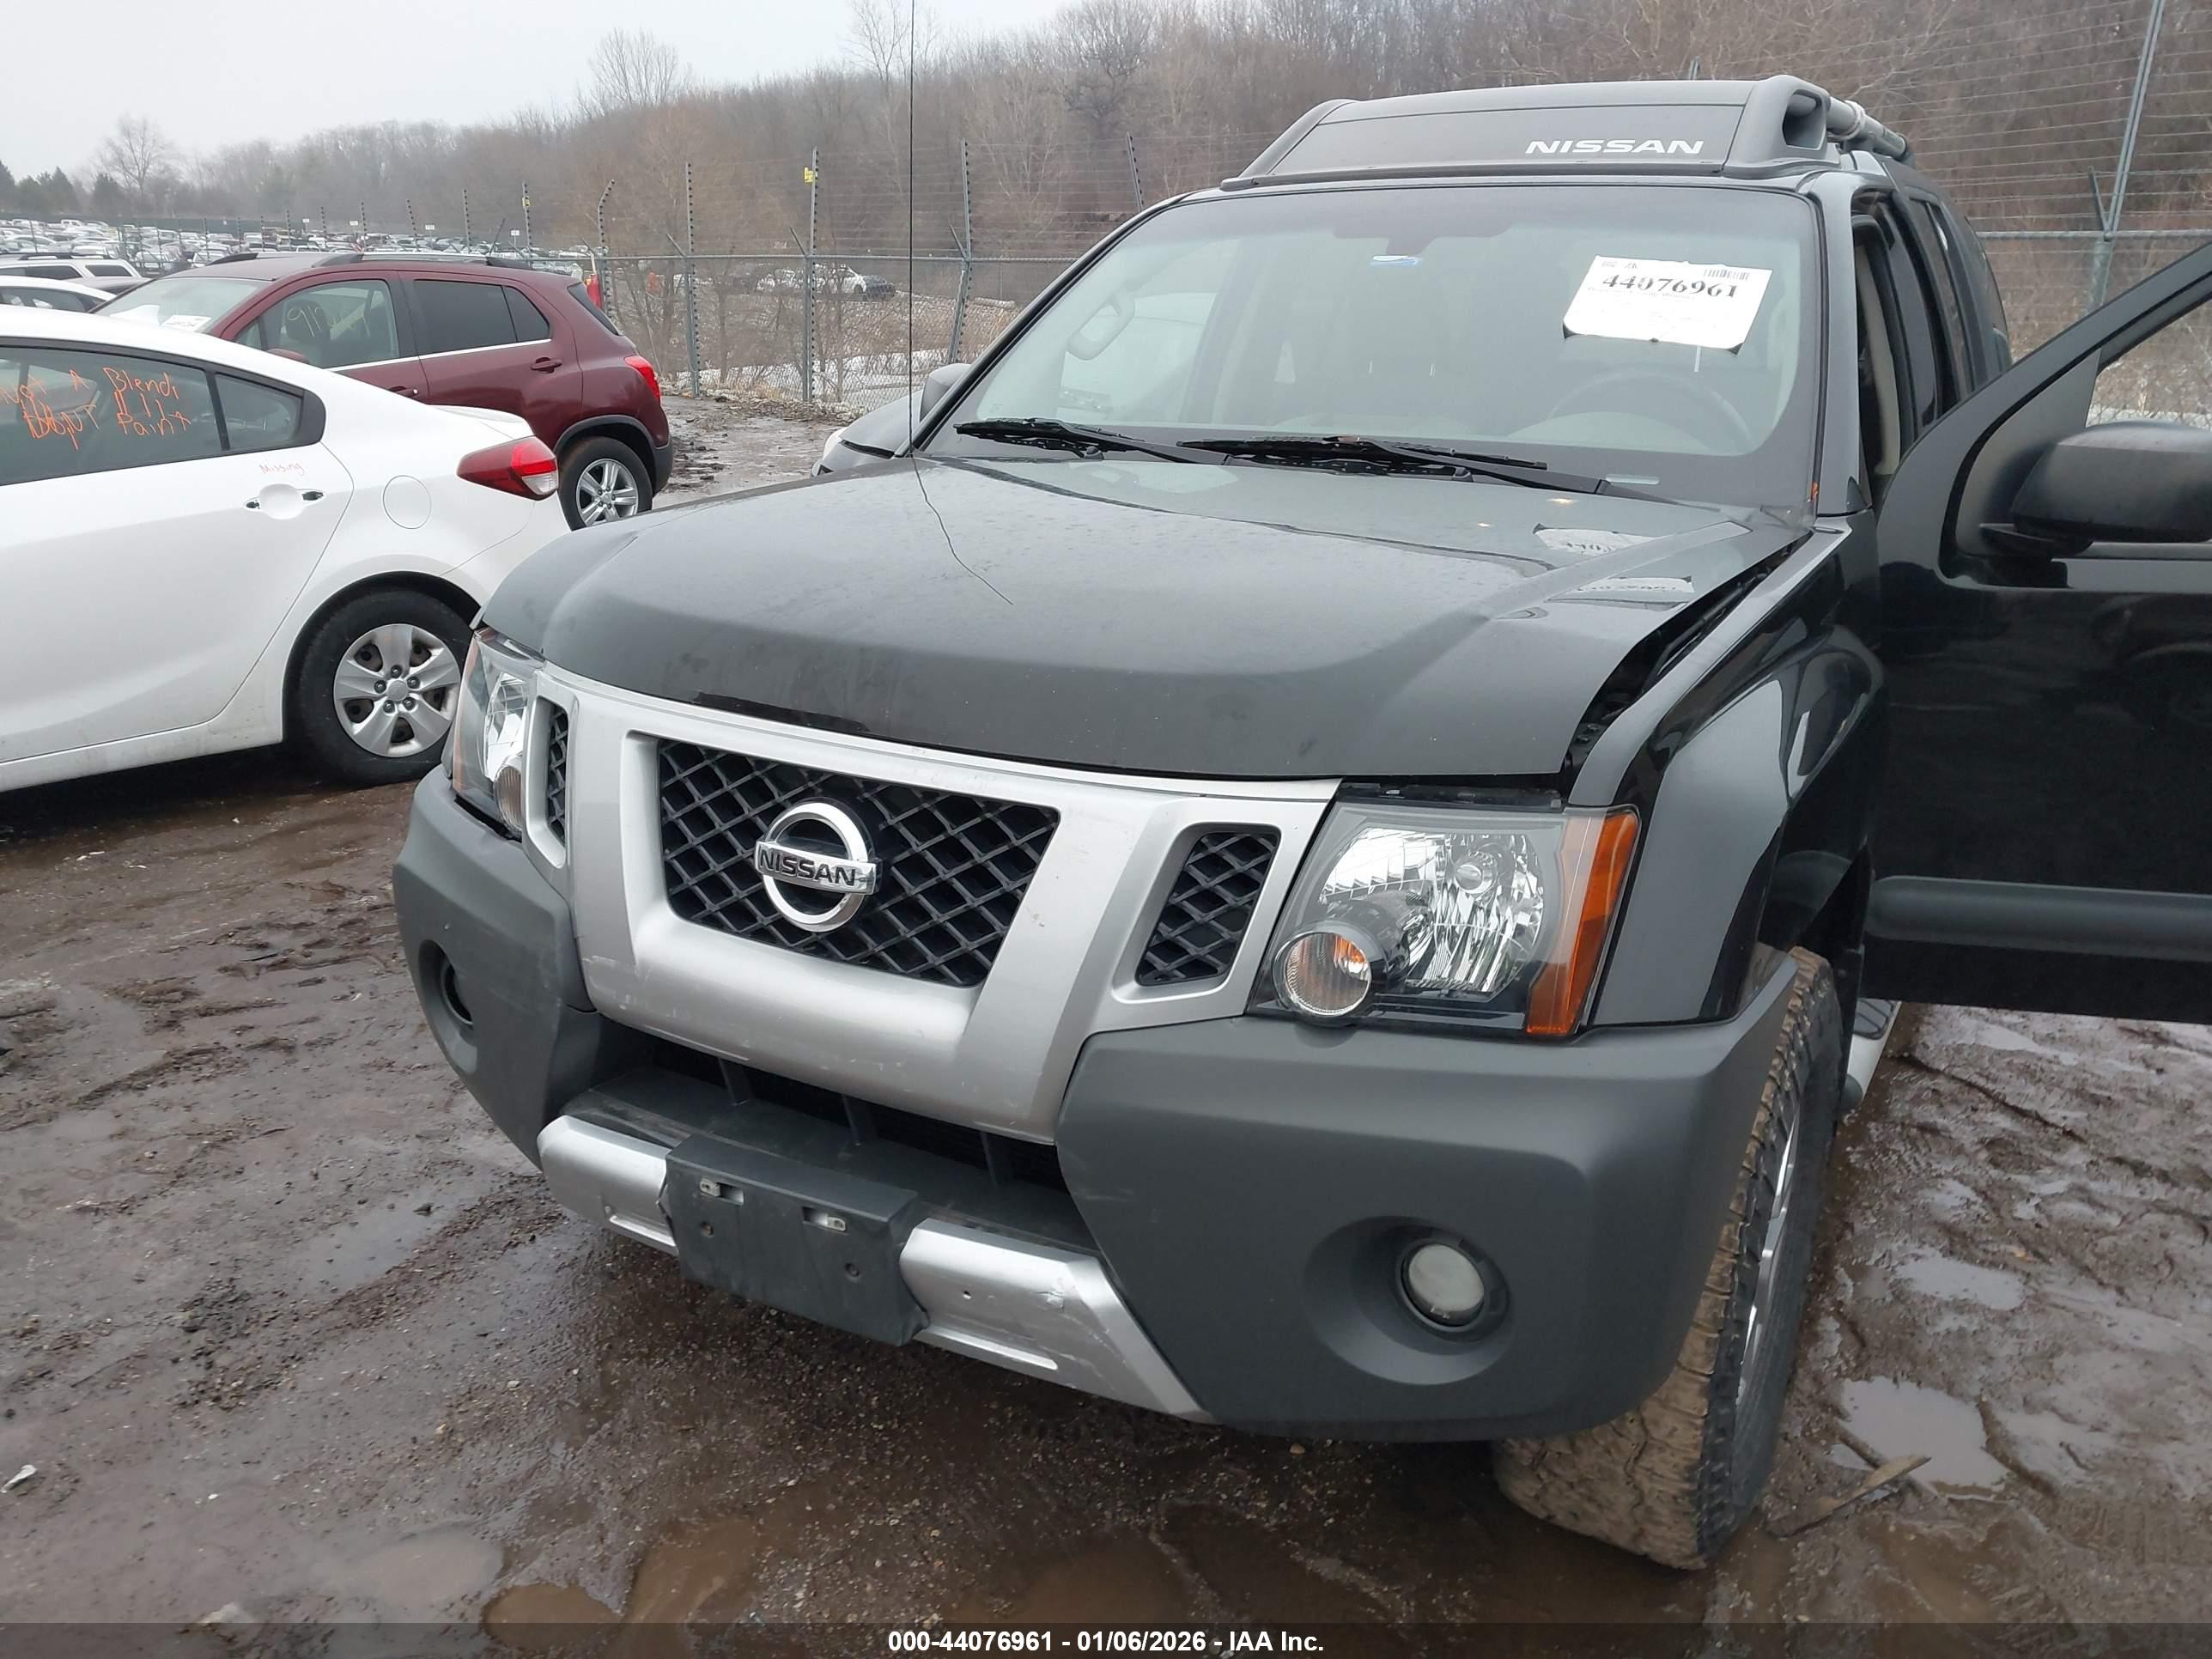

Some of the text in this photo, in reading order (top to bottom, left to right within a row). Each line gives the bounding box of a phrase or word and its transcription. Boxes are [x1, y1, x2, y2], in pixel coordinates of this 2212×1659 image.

[1525, 139, 1705, 154] NISSAN
[1602, 273, 1738, 299] 44076961
[760, 849, 856, 886] NISSAN
